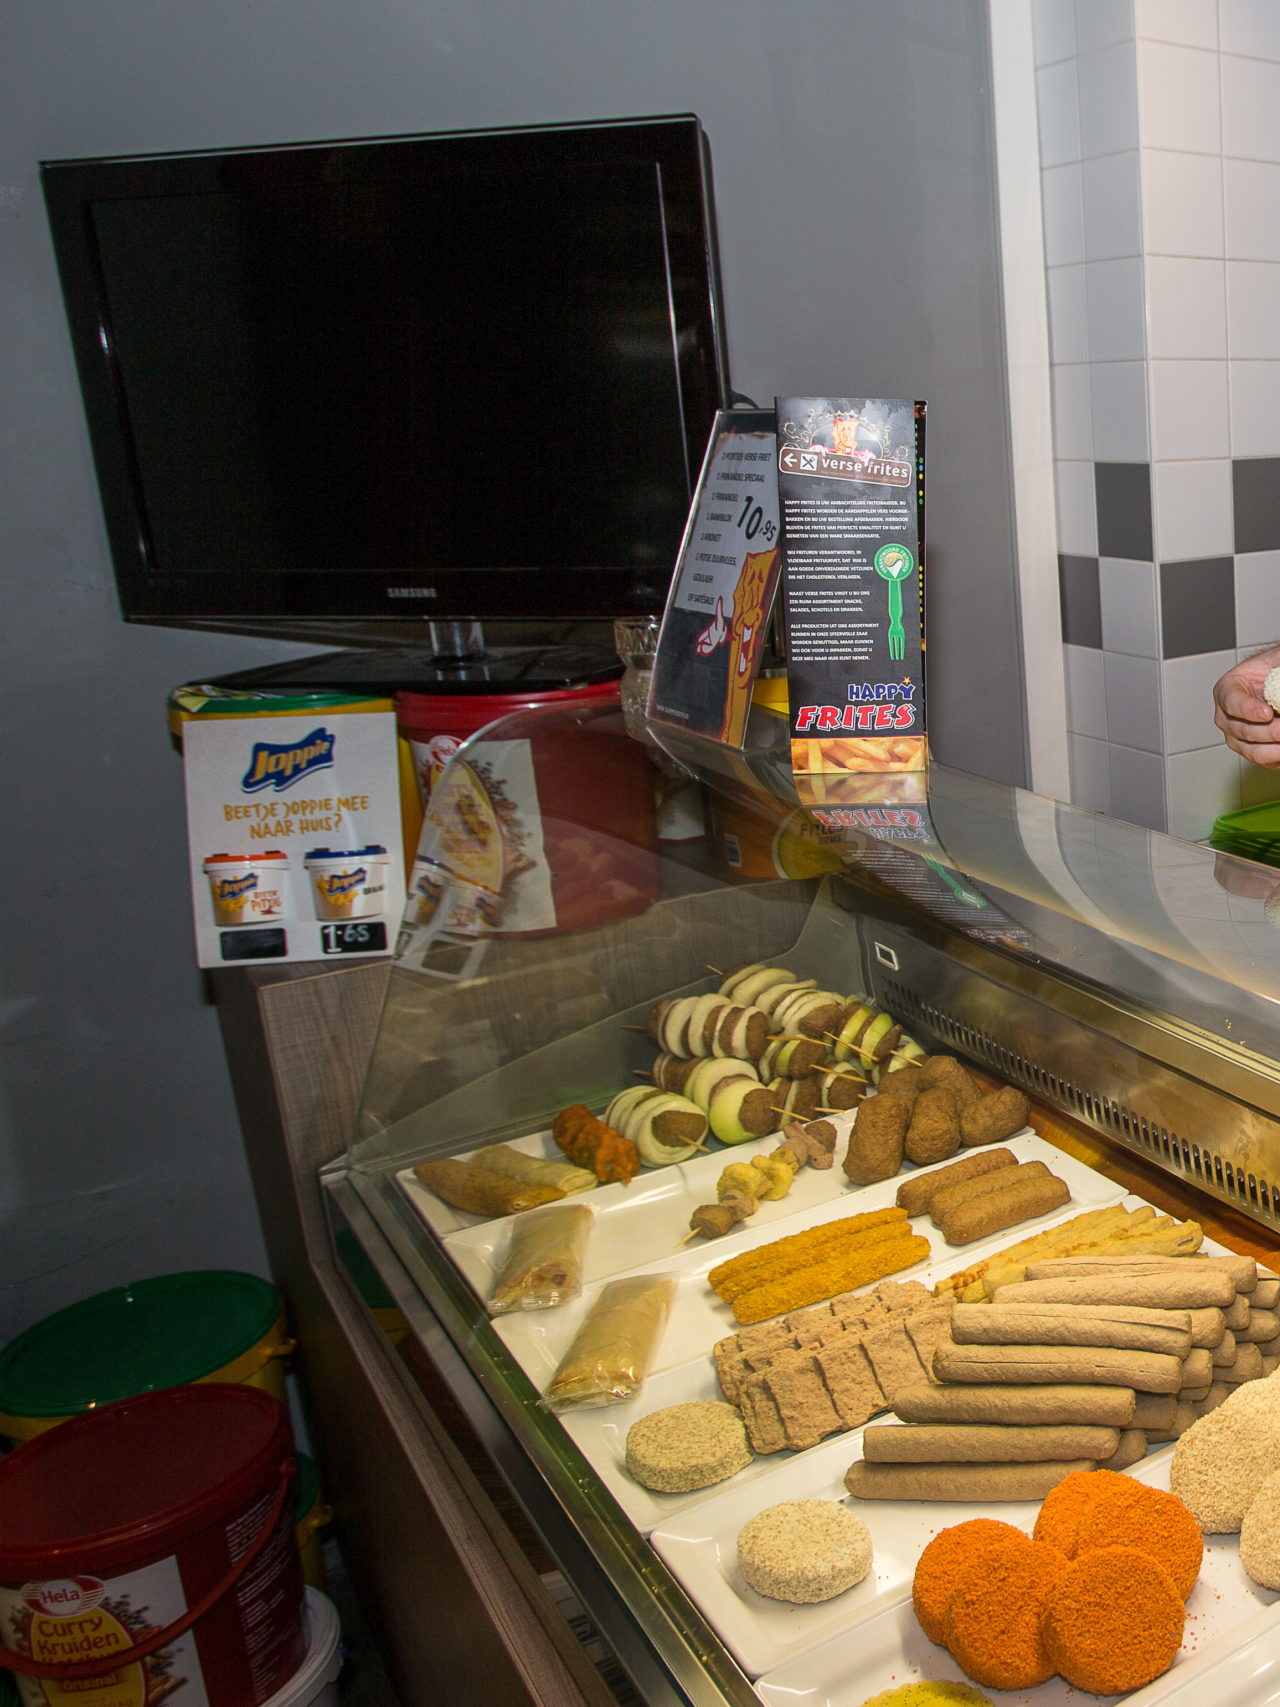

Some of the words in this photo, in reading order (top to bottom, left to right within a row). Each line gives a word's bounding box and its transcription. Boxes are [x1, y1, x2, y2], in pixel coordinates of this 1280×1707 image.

[821, 458, 863, 472] verse
[867, 462, 908, 478] frites
[848, 682, 916, 701] HAPPY
[796, 703, 917, 732] FRITES
[248, 739, 331, 782] Joppie
[223, 803, 281, 822] BEETJE
[284, 798, 333, 816] JOPPIE
[337, 796, 369, 811] MEE
[250, 821, 296, 840] NAAR
[299, 815, 342, 836] HUIS?
[41, 1588, 81, 1604] Hela
[38, 1616, 103, 1638] Curry
[38, 1632, 120, 1655] Kruiden
